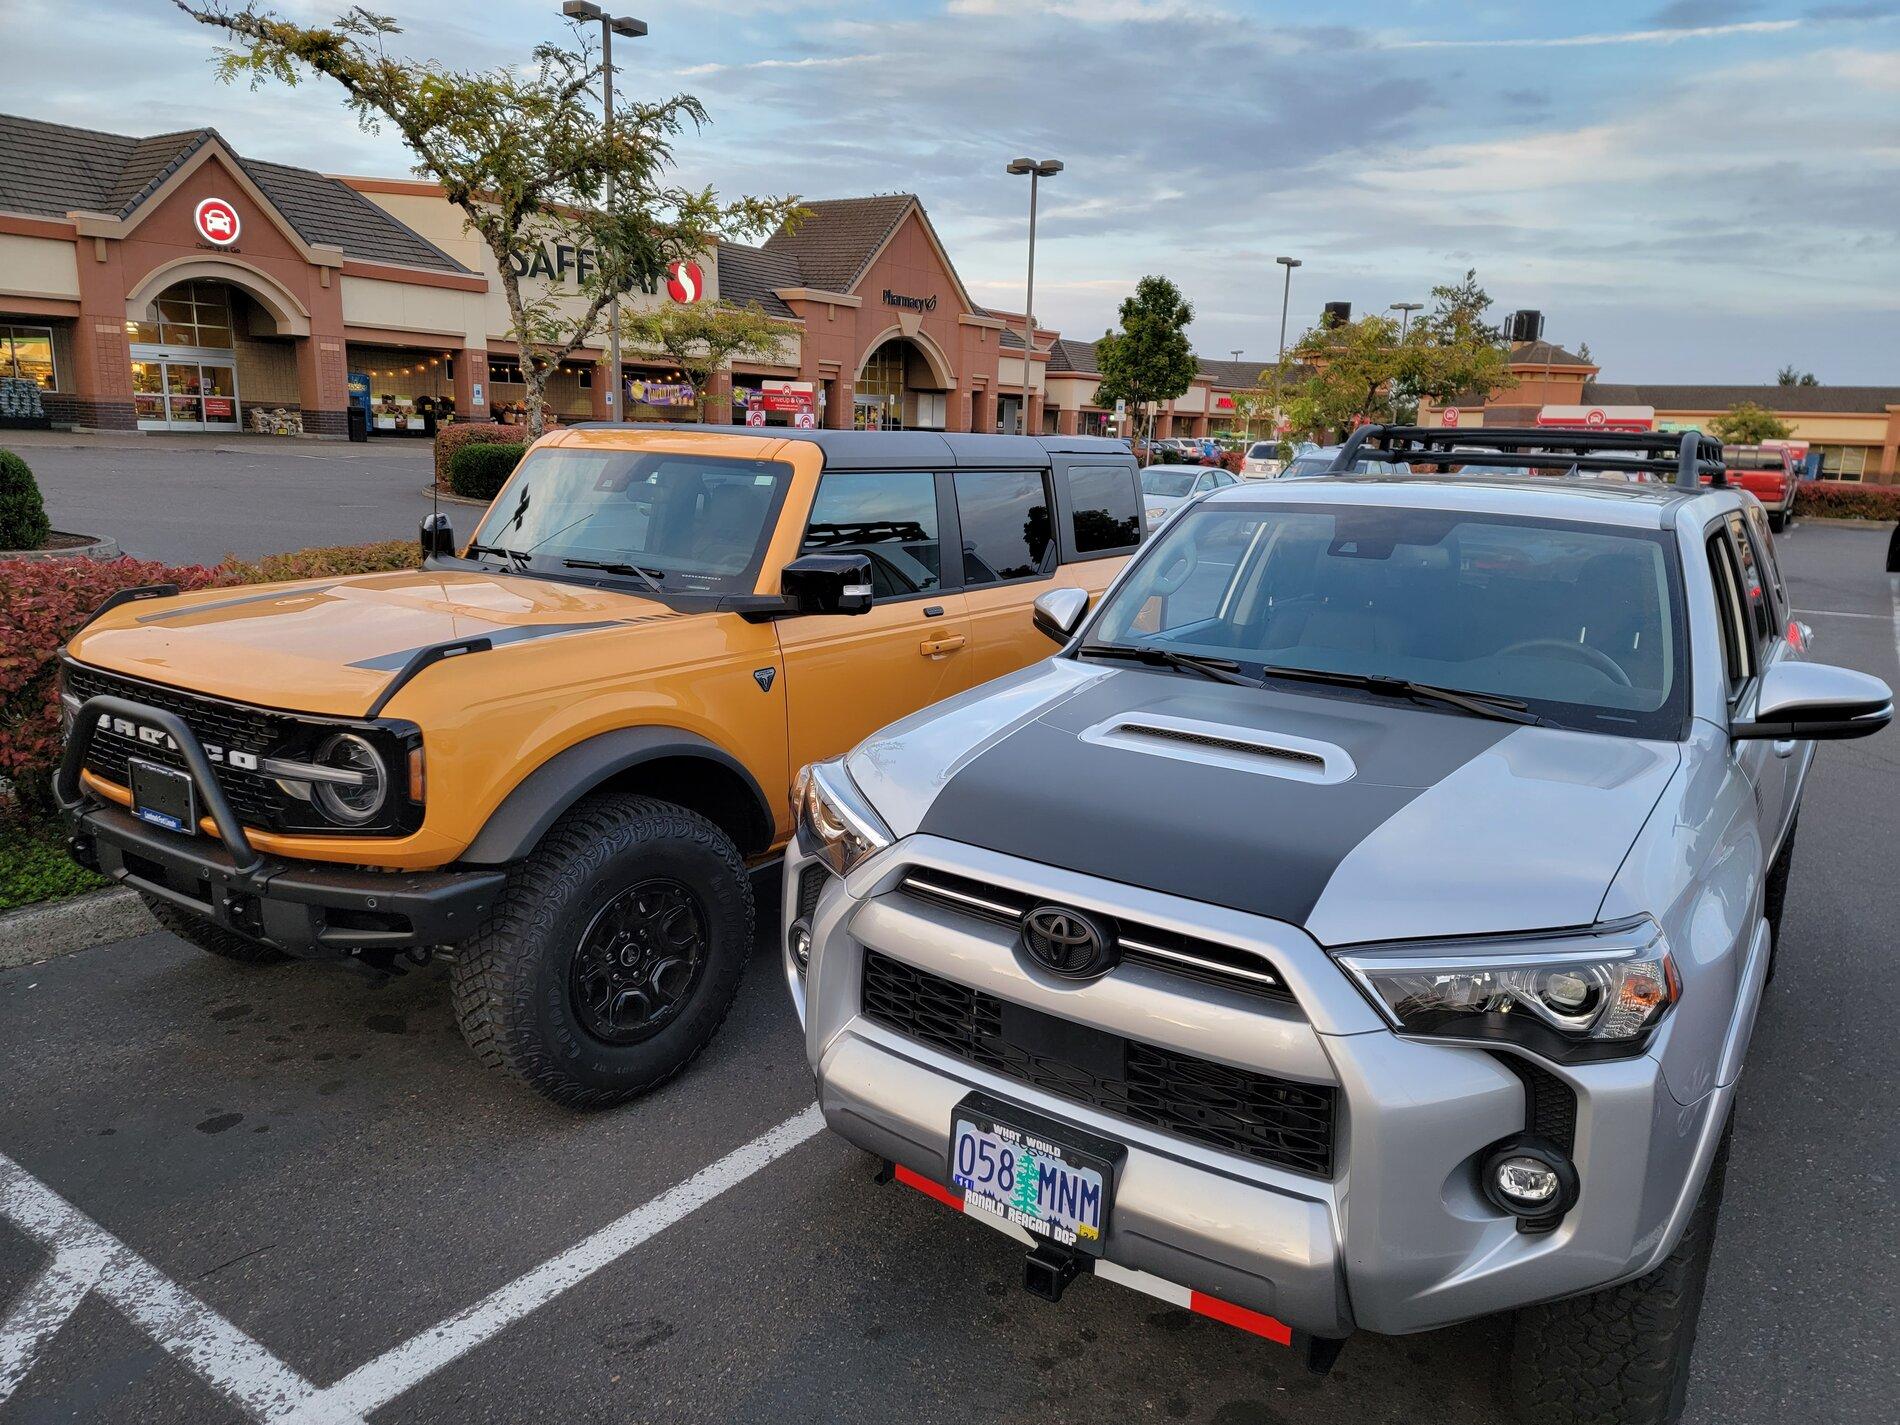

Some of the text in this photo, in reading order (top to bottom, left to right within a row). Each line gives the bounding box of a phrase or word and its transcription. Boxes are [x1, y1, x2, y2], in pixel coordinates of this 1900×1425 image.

[882, 289, 924, 313] Pharmacy
[993, 1123, 1021, 1143] WHAT
[1026, 1135, 1061, 1158] WOULD
[958, 1133, 1015, 1192] 058
[1037, 1161, 1100, 1228] MNM
[964, 1188, 1077, 1247] RONALD REAGAN DO?
